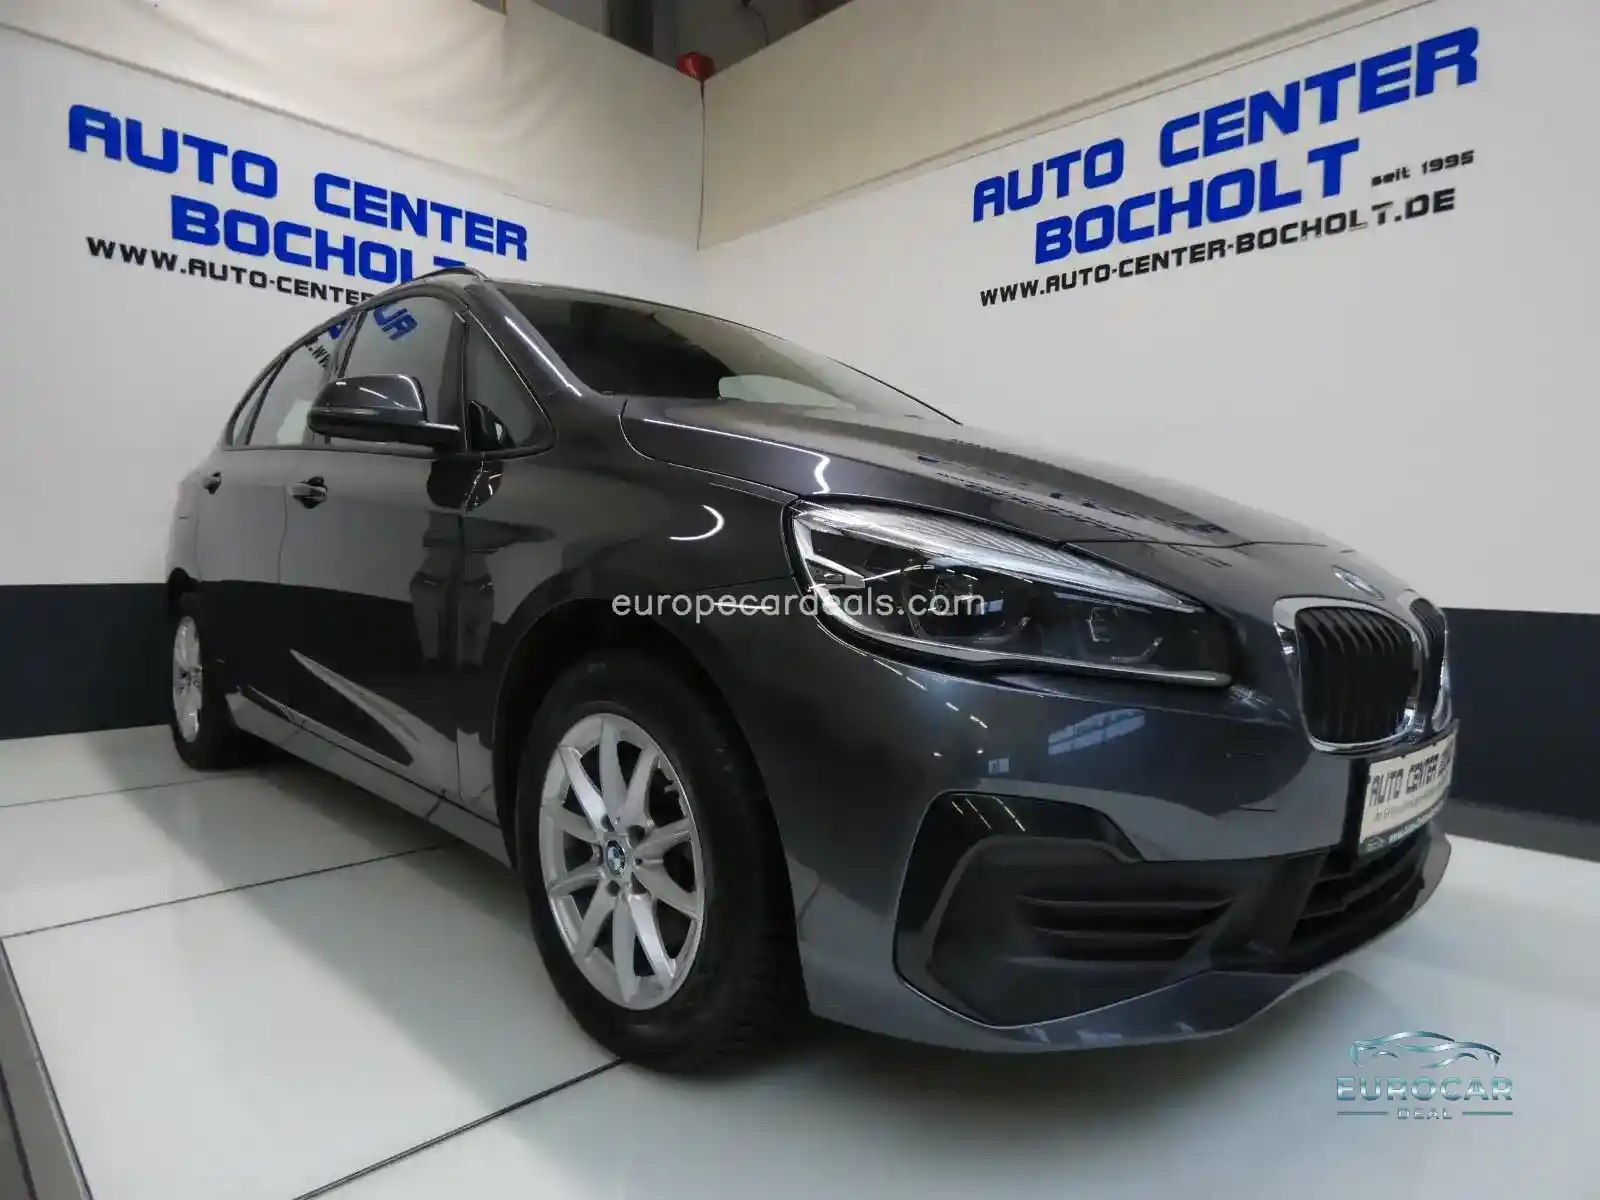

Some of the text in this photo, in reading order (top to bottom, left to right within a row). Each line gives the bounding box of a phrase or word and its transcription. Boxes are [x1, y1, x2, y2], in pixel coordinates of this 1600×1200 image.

[68, 104, 528, 261] AUTO CENTER
[973, 27, 1480, 222] AUTO CENTER
[1371, 150, 1475, 187] seit 1995
[171, 196, 466, 286] BOCHOL
[981, 188, 1456, 307] WWW.AUTO-CENTER-BOCHOLT.DE
[1036, 138, 1360, 265] BOCHOLT
[1369, 768, 1404, 807] AUTO
